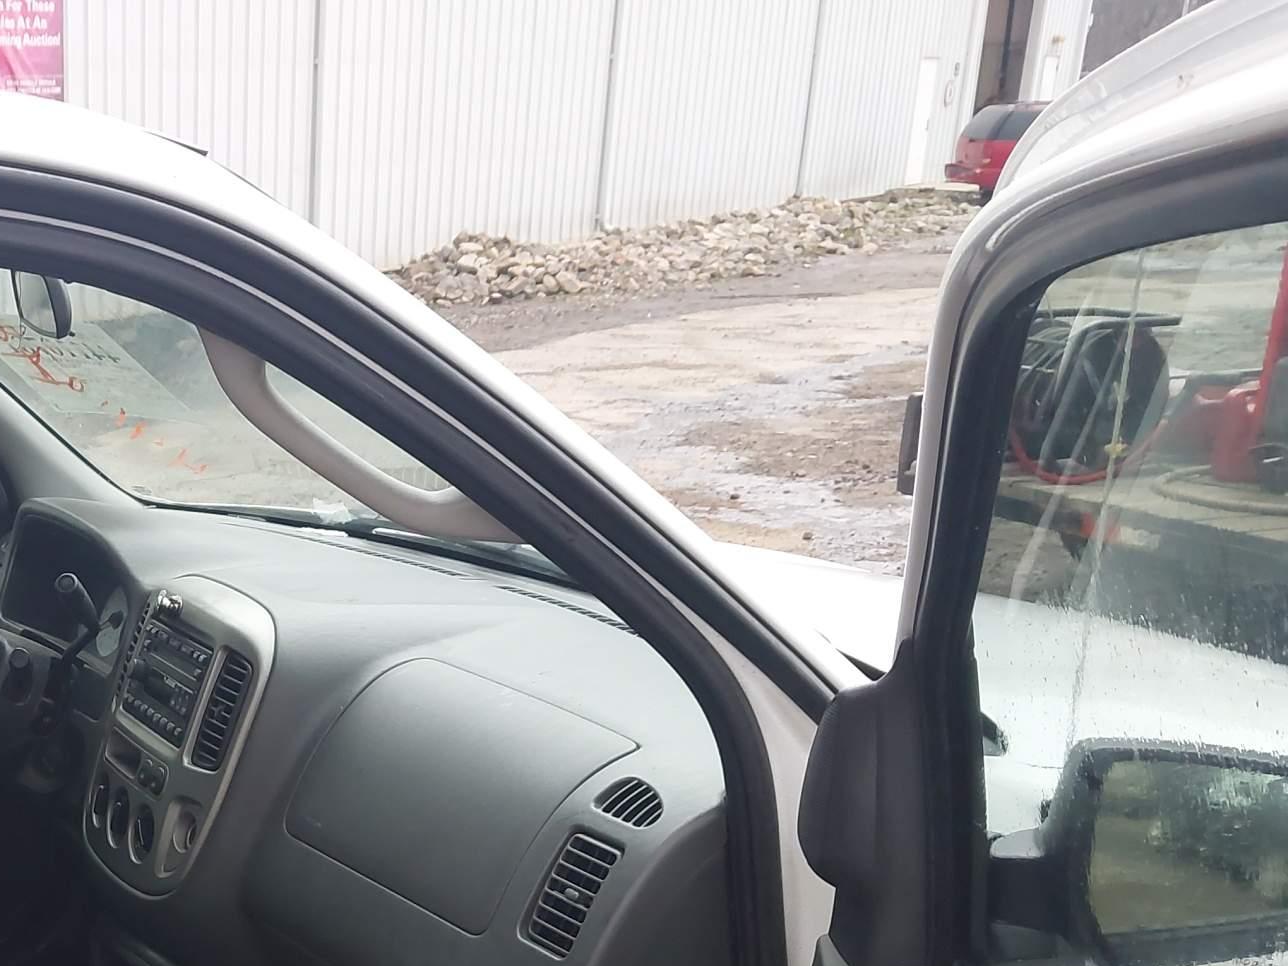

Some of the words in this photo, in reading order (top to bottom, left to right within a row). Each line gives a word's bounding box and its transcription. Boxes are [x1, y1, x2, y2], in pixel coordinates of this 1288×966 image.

[6, 0, 22, 12] For
[25, 0, 55, 13] These
[18, 15, 30, 29] At
[33, 16, 47, 30] An
